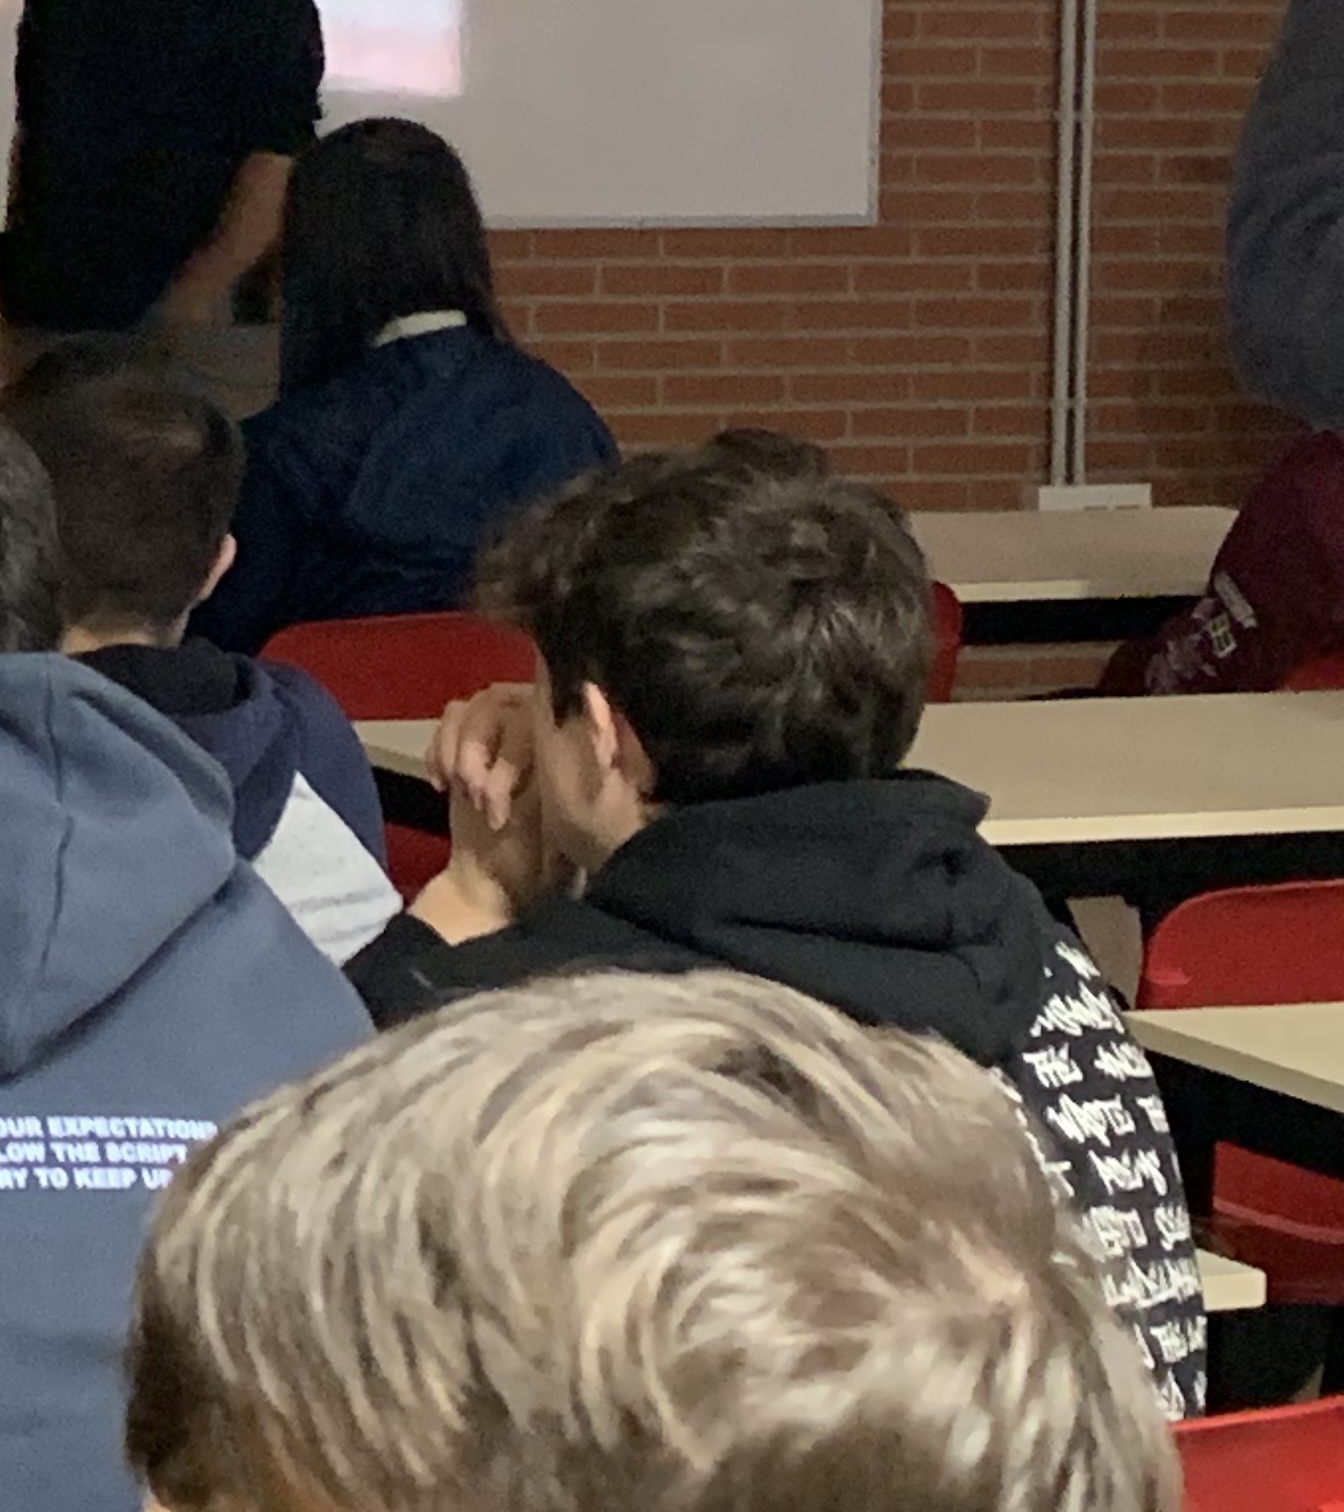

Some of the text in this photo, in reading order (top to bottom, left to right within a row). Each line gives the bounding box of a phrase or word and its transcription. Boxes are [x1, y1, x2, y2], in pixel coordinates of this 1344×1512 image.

[49, 1141, 102, 1164] THE
[32, 1166, 70, 1190] TO
[72, 1167, 139, 1190] KEEP
